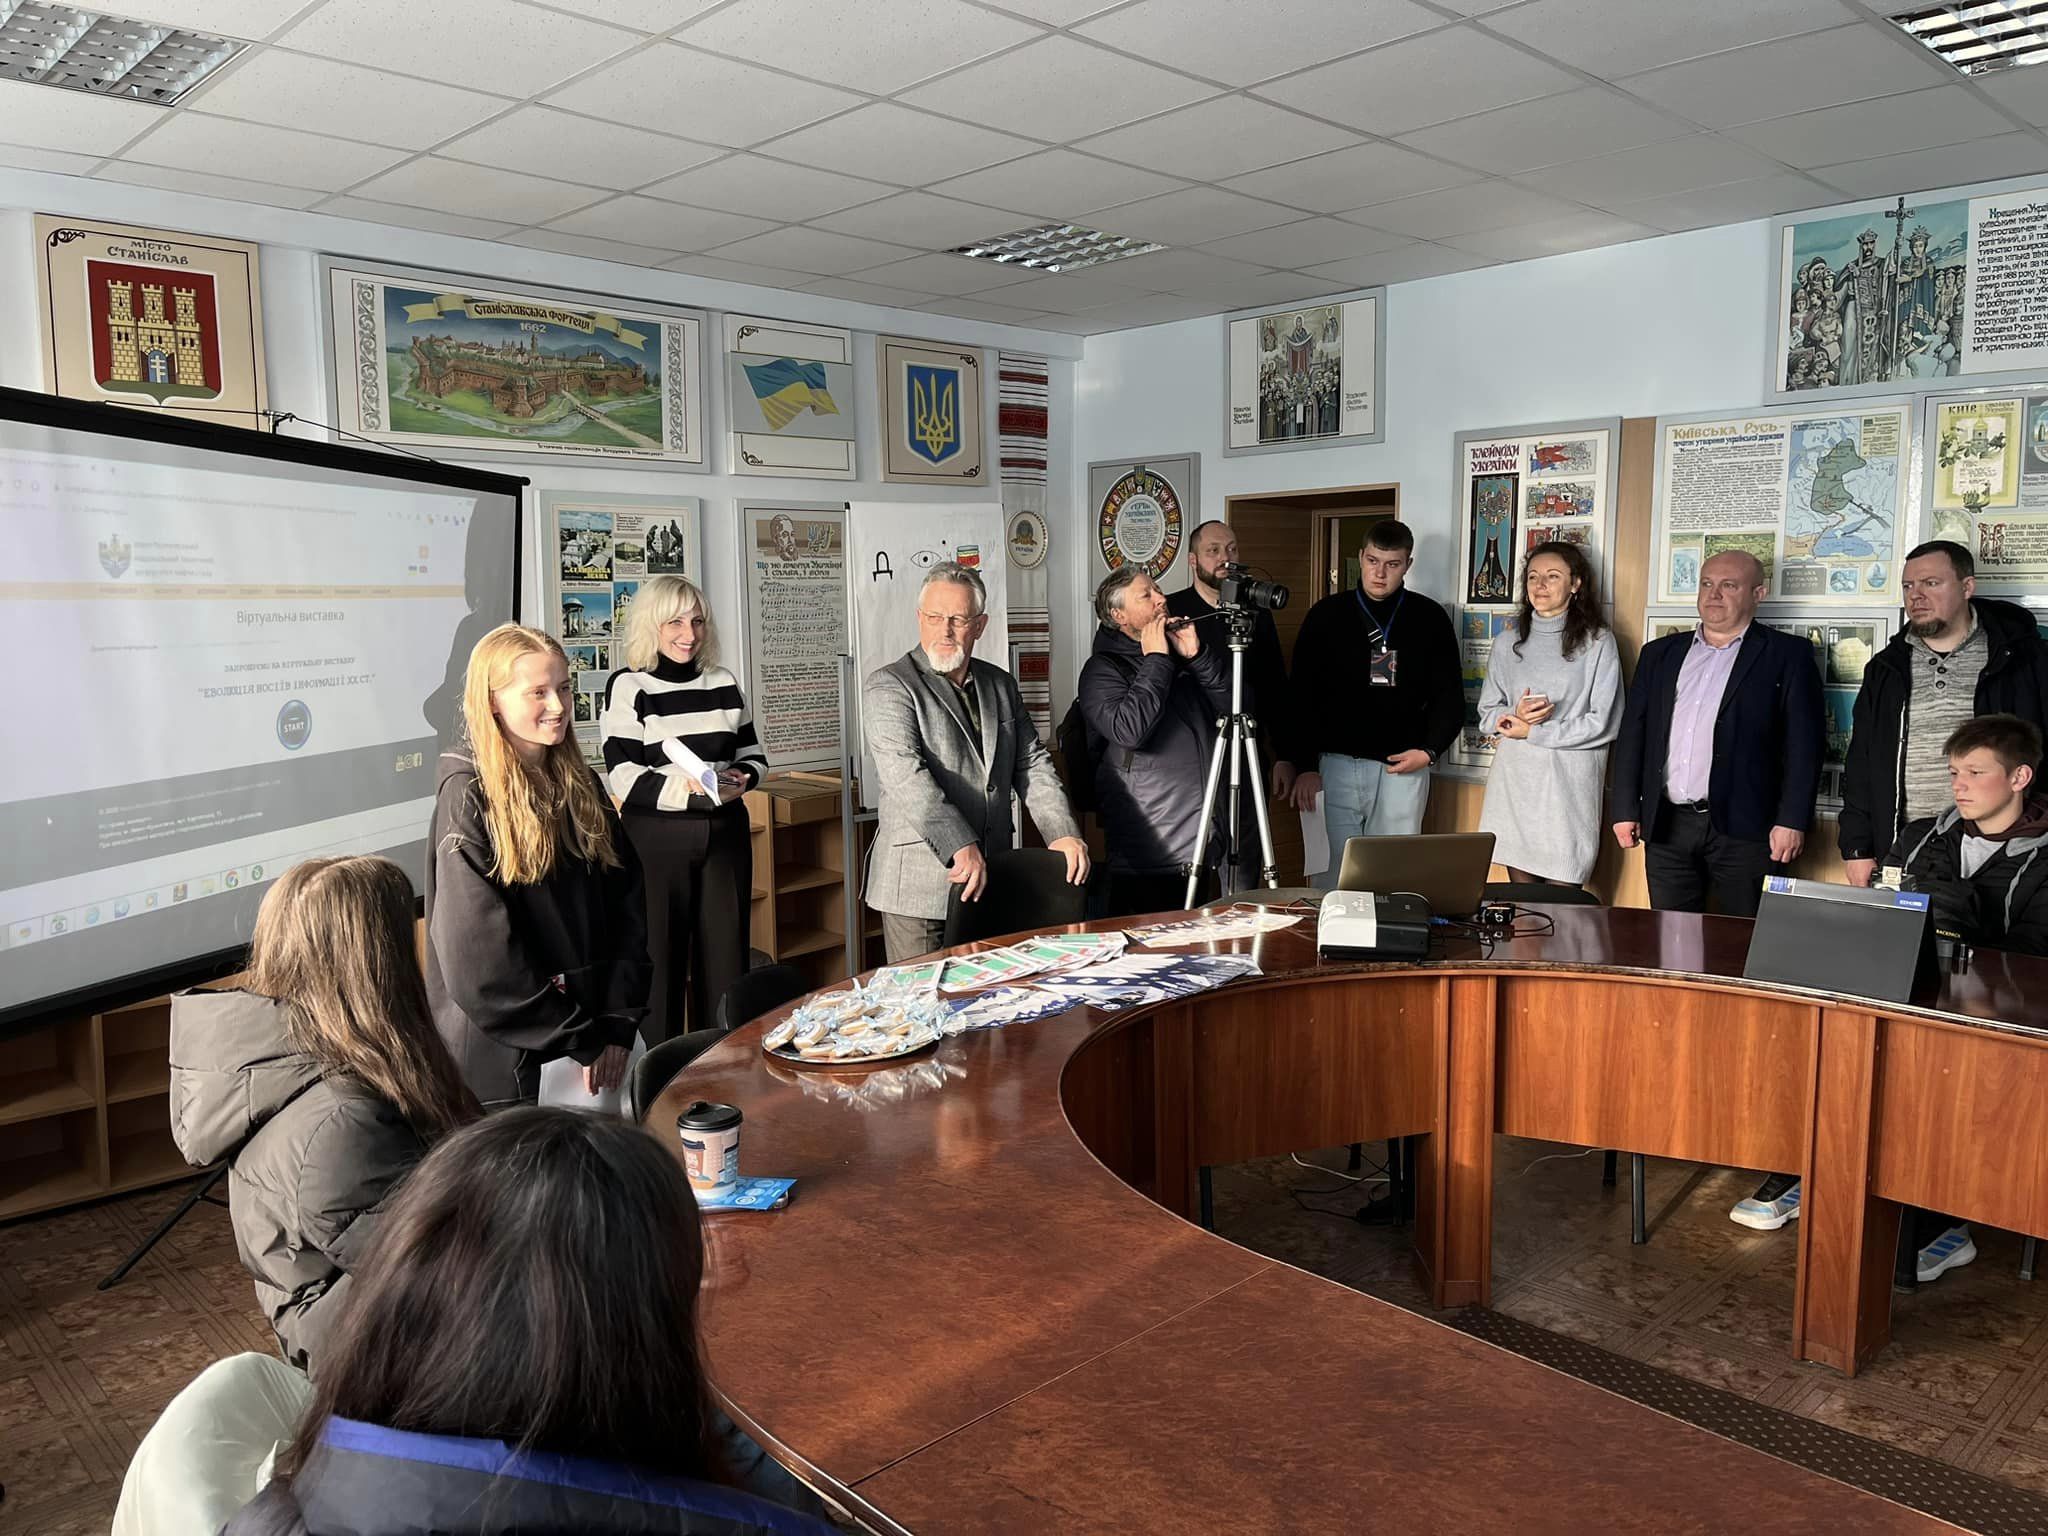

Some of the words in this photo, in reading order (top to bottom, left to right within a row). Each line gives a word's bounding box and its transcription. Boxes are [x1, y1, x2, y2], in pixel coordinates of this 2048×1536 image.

[520, 322, 547, 333] 1662
[236, 610, 297, 627] Віртуальна
[300, 611, 344, 622] виставка
[284, 721, 305, 733] START
